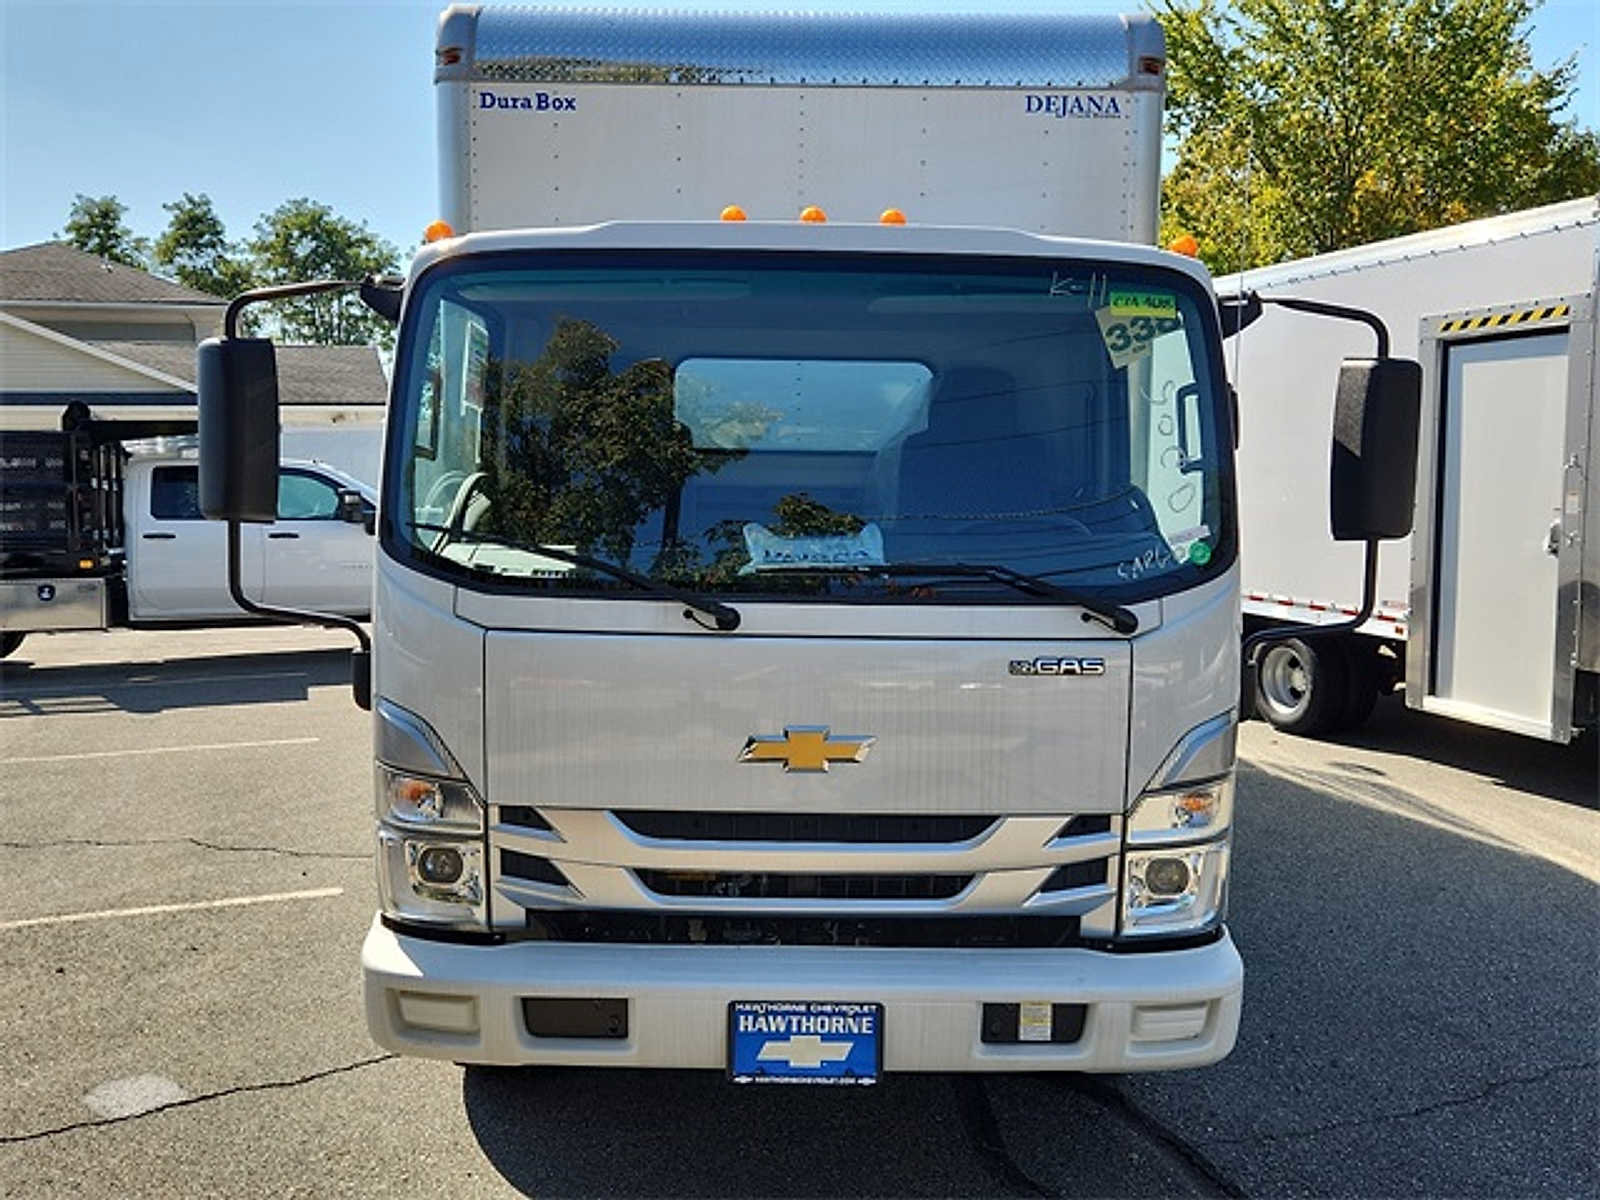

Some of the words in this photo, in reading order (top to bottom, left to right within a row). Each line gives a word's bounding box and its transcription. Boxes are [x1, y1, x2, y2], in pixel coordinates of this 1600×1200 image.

[480, 92, 532, 109] Dura
[535, 92, 576, 111] Box
[1025, 95, 1120, 116] DEJANA
[1036, 658, 1104, 675] GAS
[739, 1015, 875, 1034] HAWTHORNE
